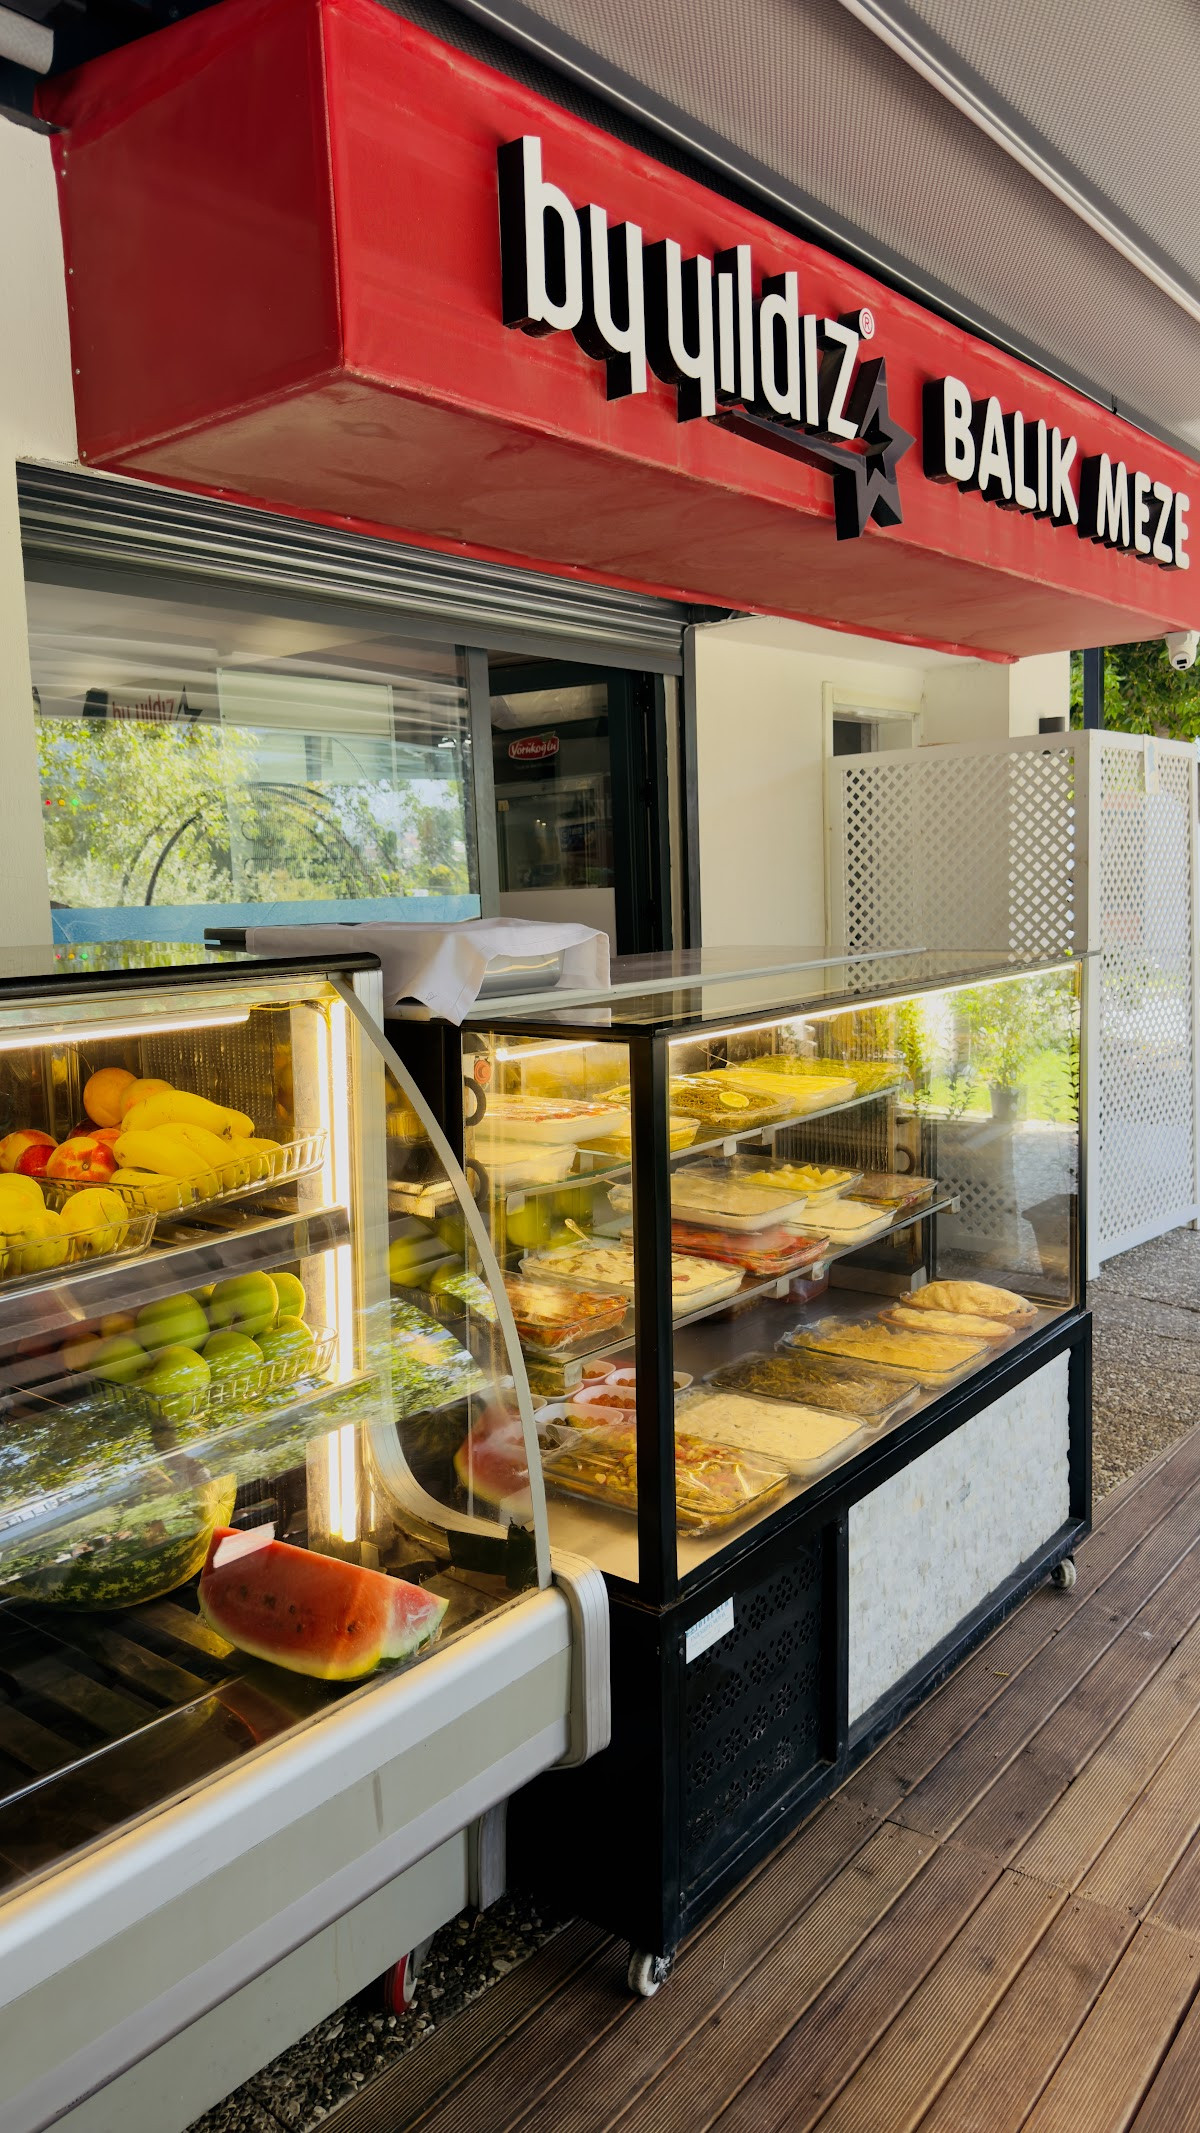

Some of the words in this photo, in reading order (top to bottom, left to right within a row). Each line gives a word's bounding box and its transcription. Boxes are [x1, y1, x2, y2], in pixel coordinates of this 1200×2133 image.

[521, 136, 647, 394] by
[943, 375, 1079, 526] BALIK
[1096, 452, 1190, 571] MEZE
